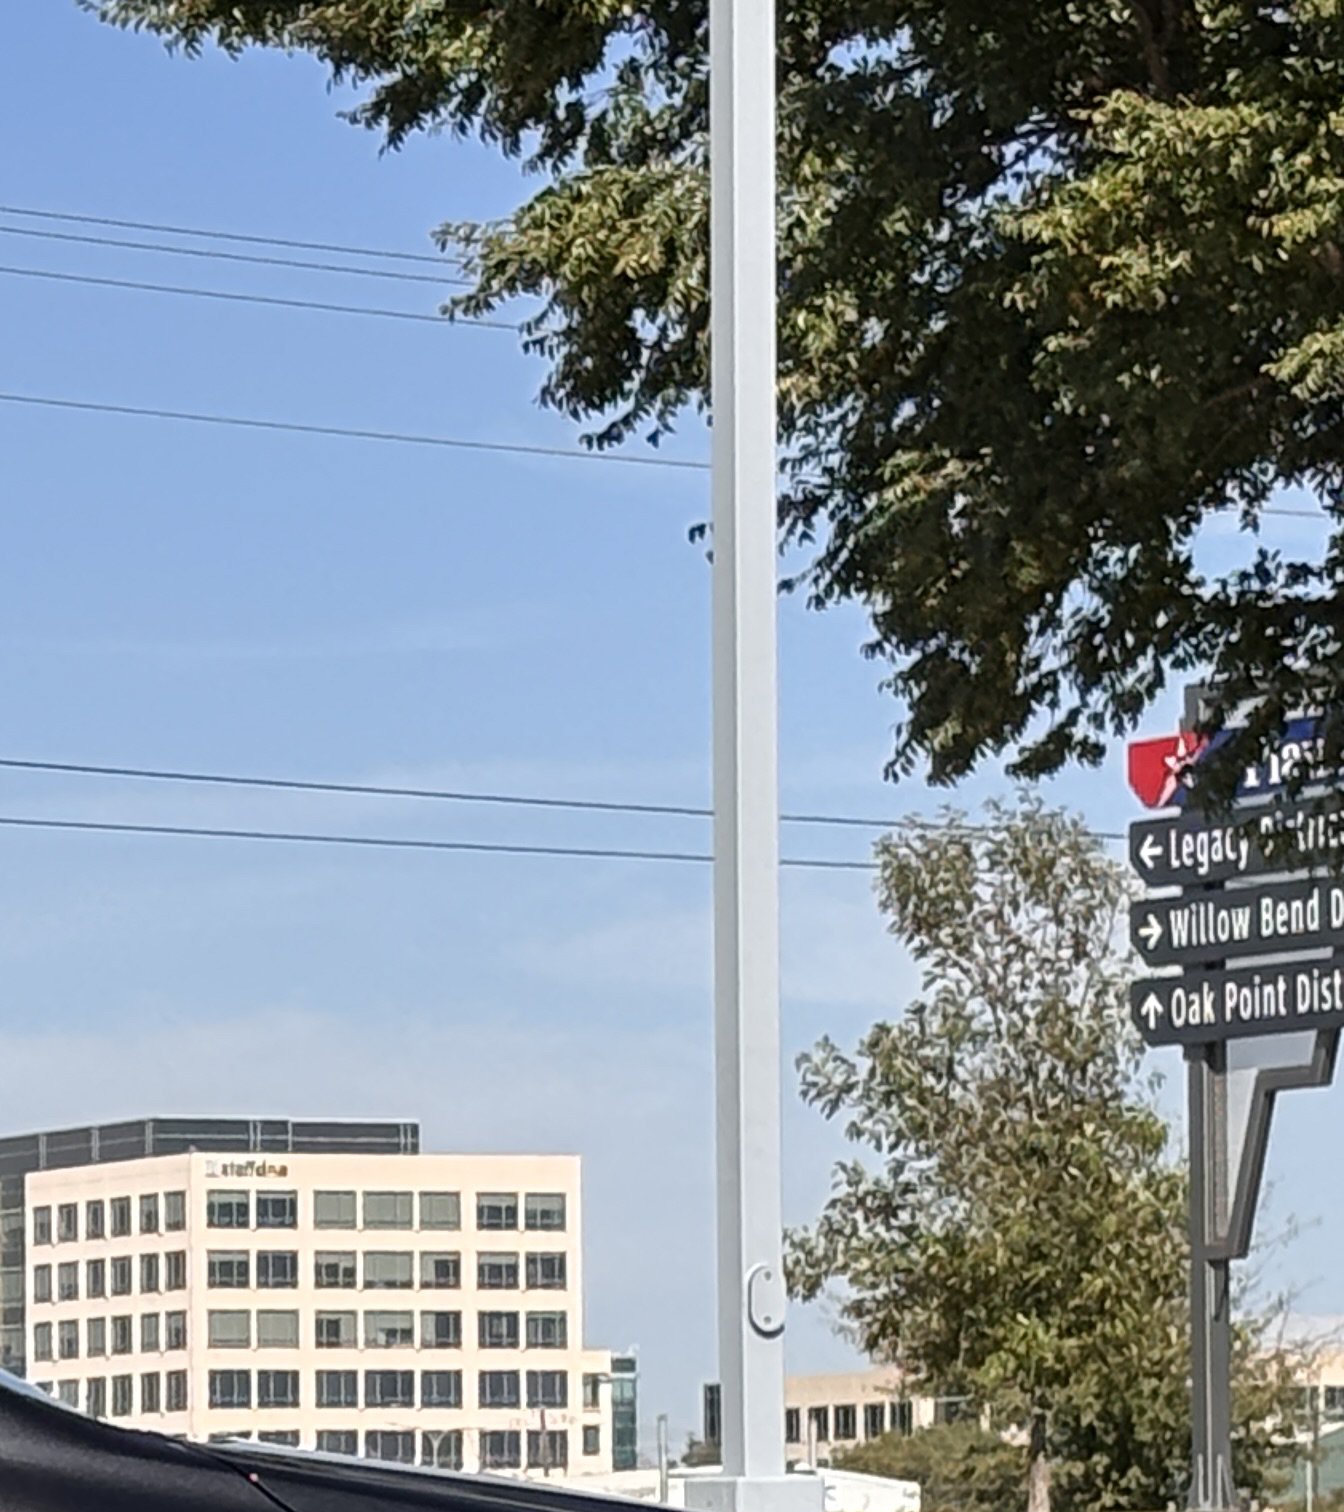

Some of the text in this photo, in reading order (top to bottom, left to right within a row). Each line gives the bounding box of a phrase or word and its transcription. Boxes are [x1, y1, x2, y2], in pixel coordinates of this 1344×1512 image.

[1169, 827, 1249, 876] Legacy
[1169, 902, 1251, 948] Willow
[1260, 887, 1320, 938] Bend
[1171, 968, 1344, 1028] Oak Point Dist
